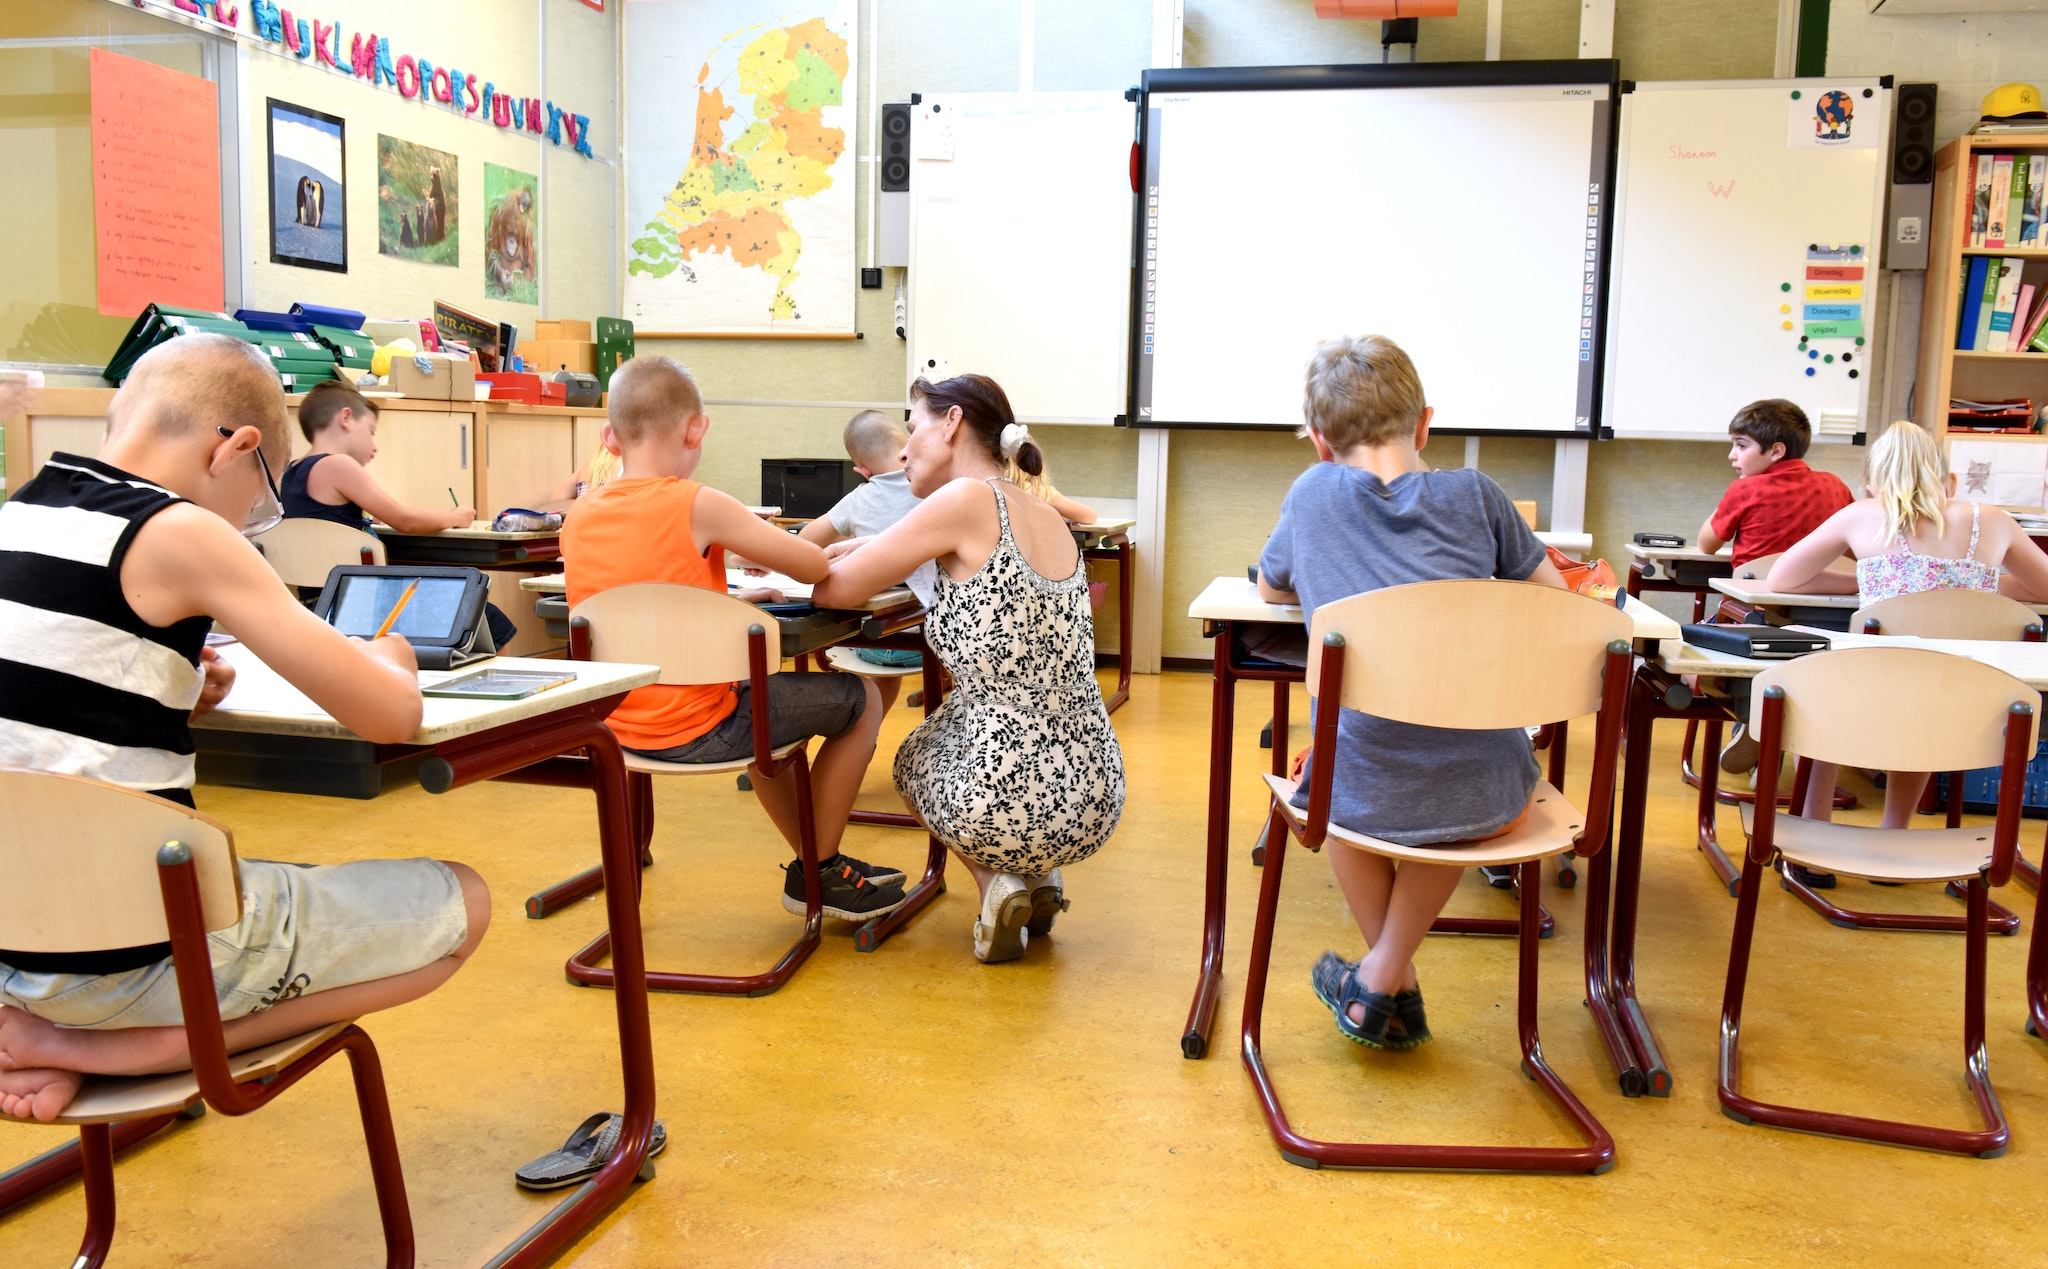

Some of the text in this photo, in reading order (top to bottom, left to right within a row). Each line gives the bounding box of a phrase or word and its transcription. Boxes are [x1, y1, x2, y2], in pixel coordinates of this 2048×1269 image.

[1707, 179, 1736, 199] W
[1814, 269, 1843, 277] Dinsdag
[1814, 287, 1851, 295] Woensdag
[1812, 326, 1837, 334] Vrijdag
